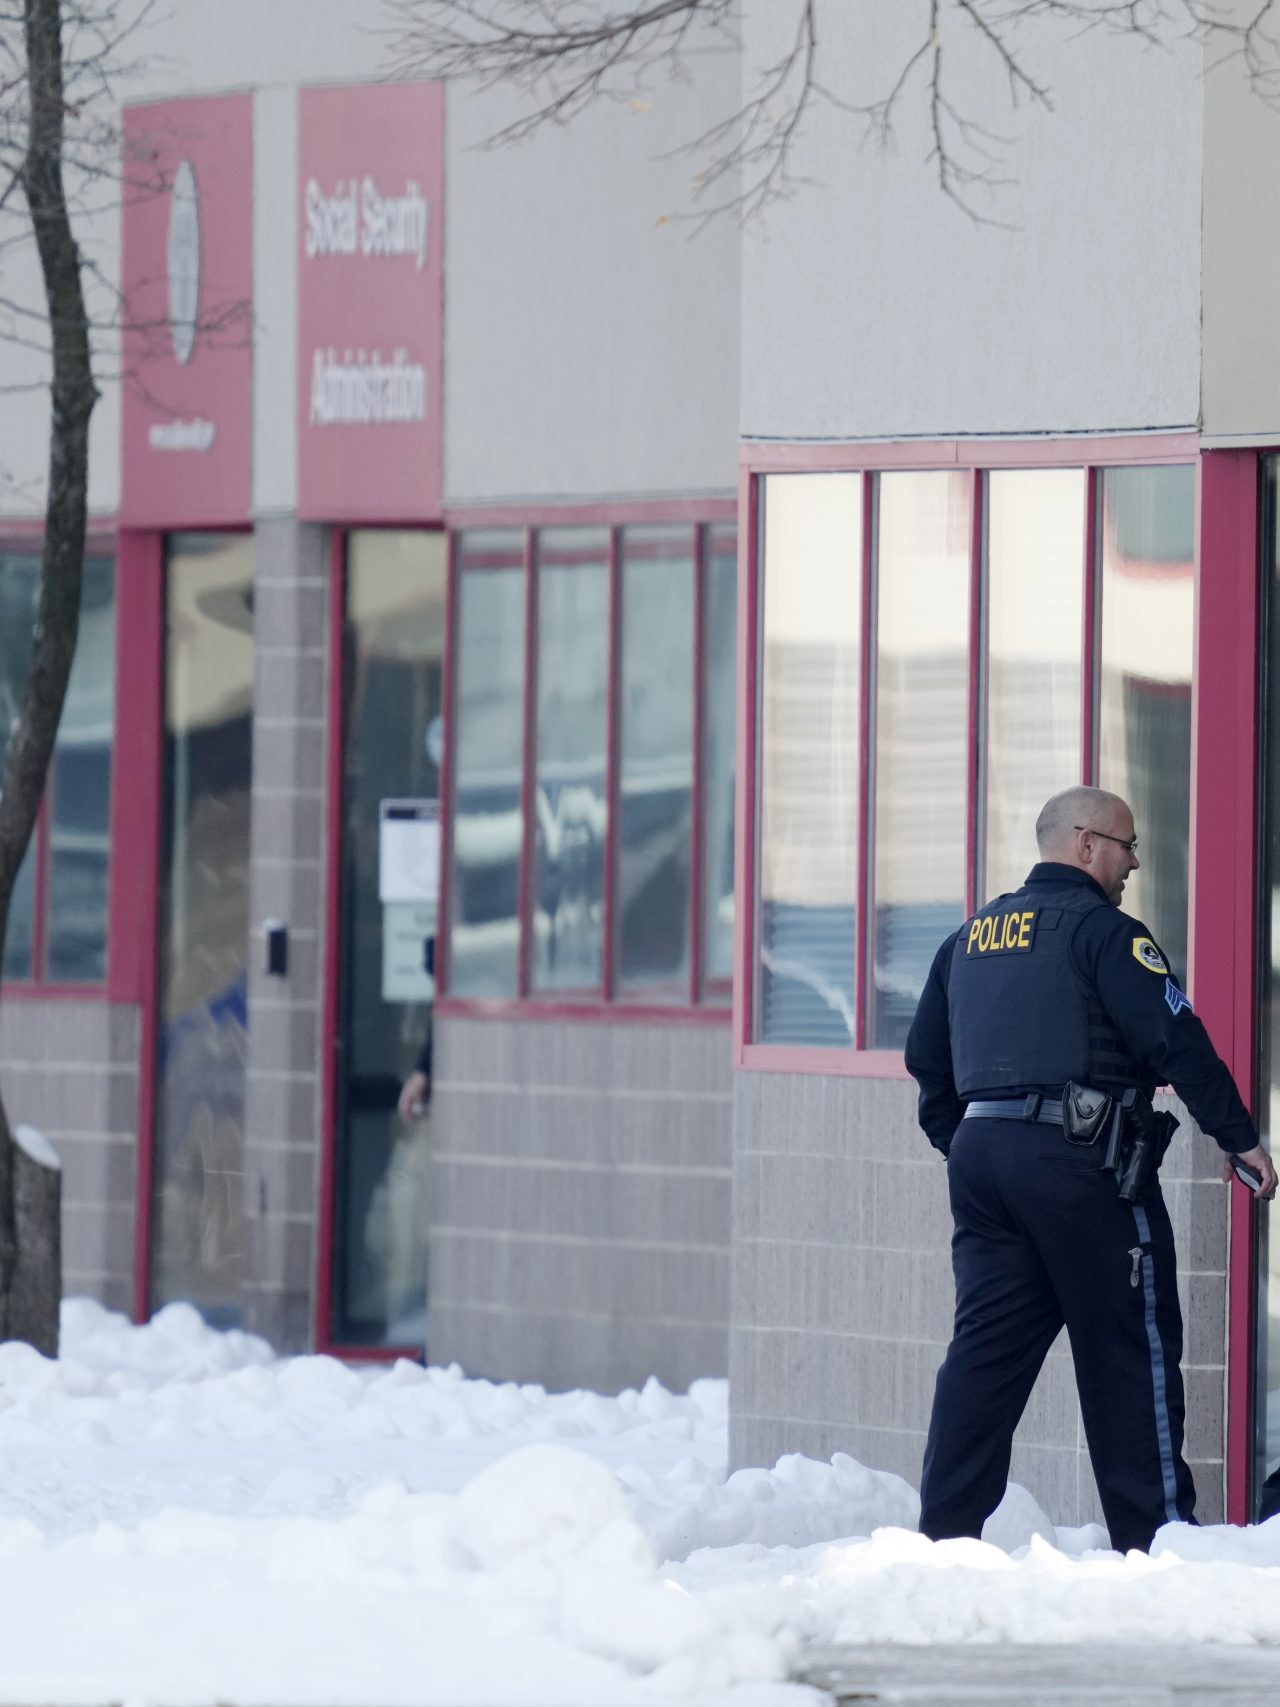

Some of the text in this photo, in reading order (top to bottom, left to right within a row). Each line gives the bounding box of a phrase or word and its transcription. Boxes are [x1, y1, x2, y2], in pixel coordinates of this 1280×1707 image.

[305, 175, 429, 271] Social Security
[966, 912, 1034, 954] POLICE
